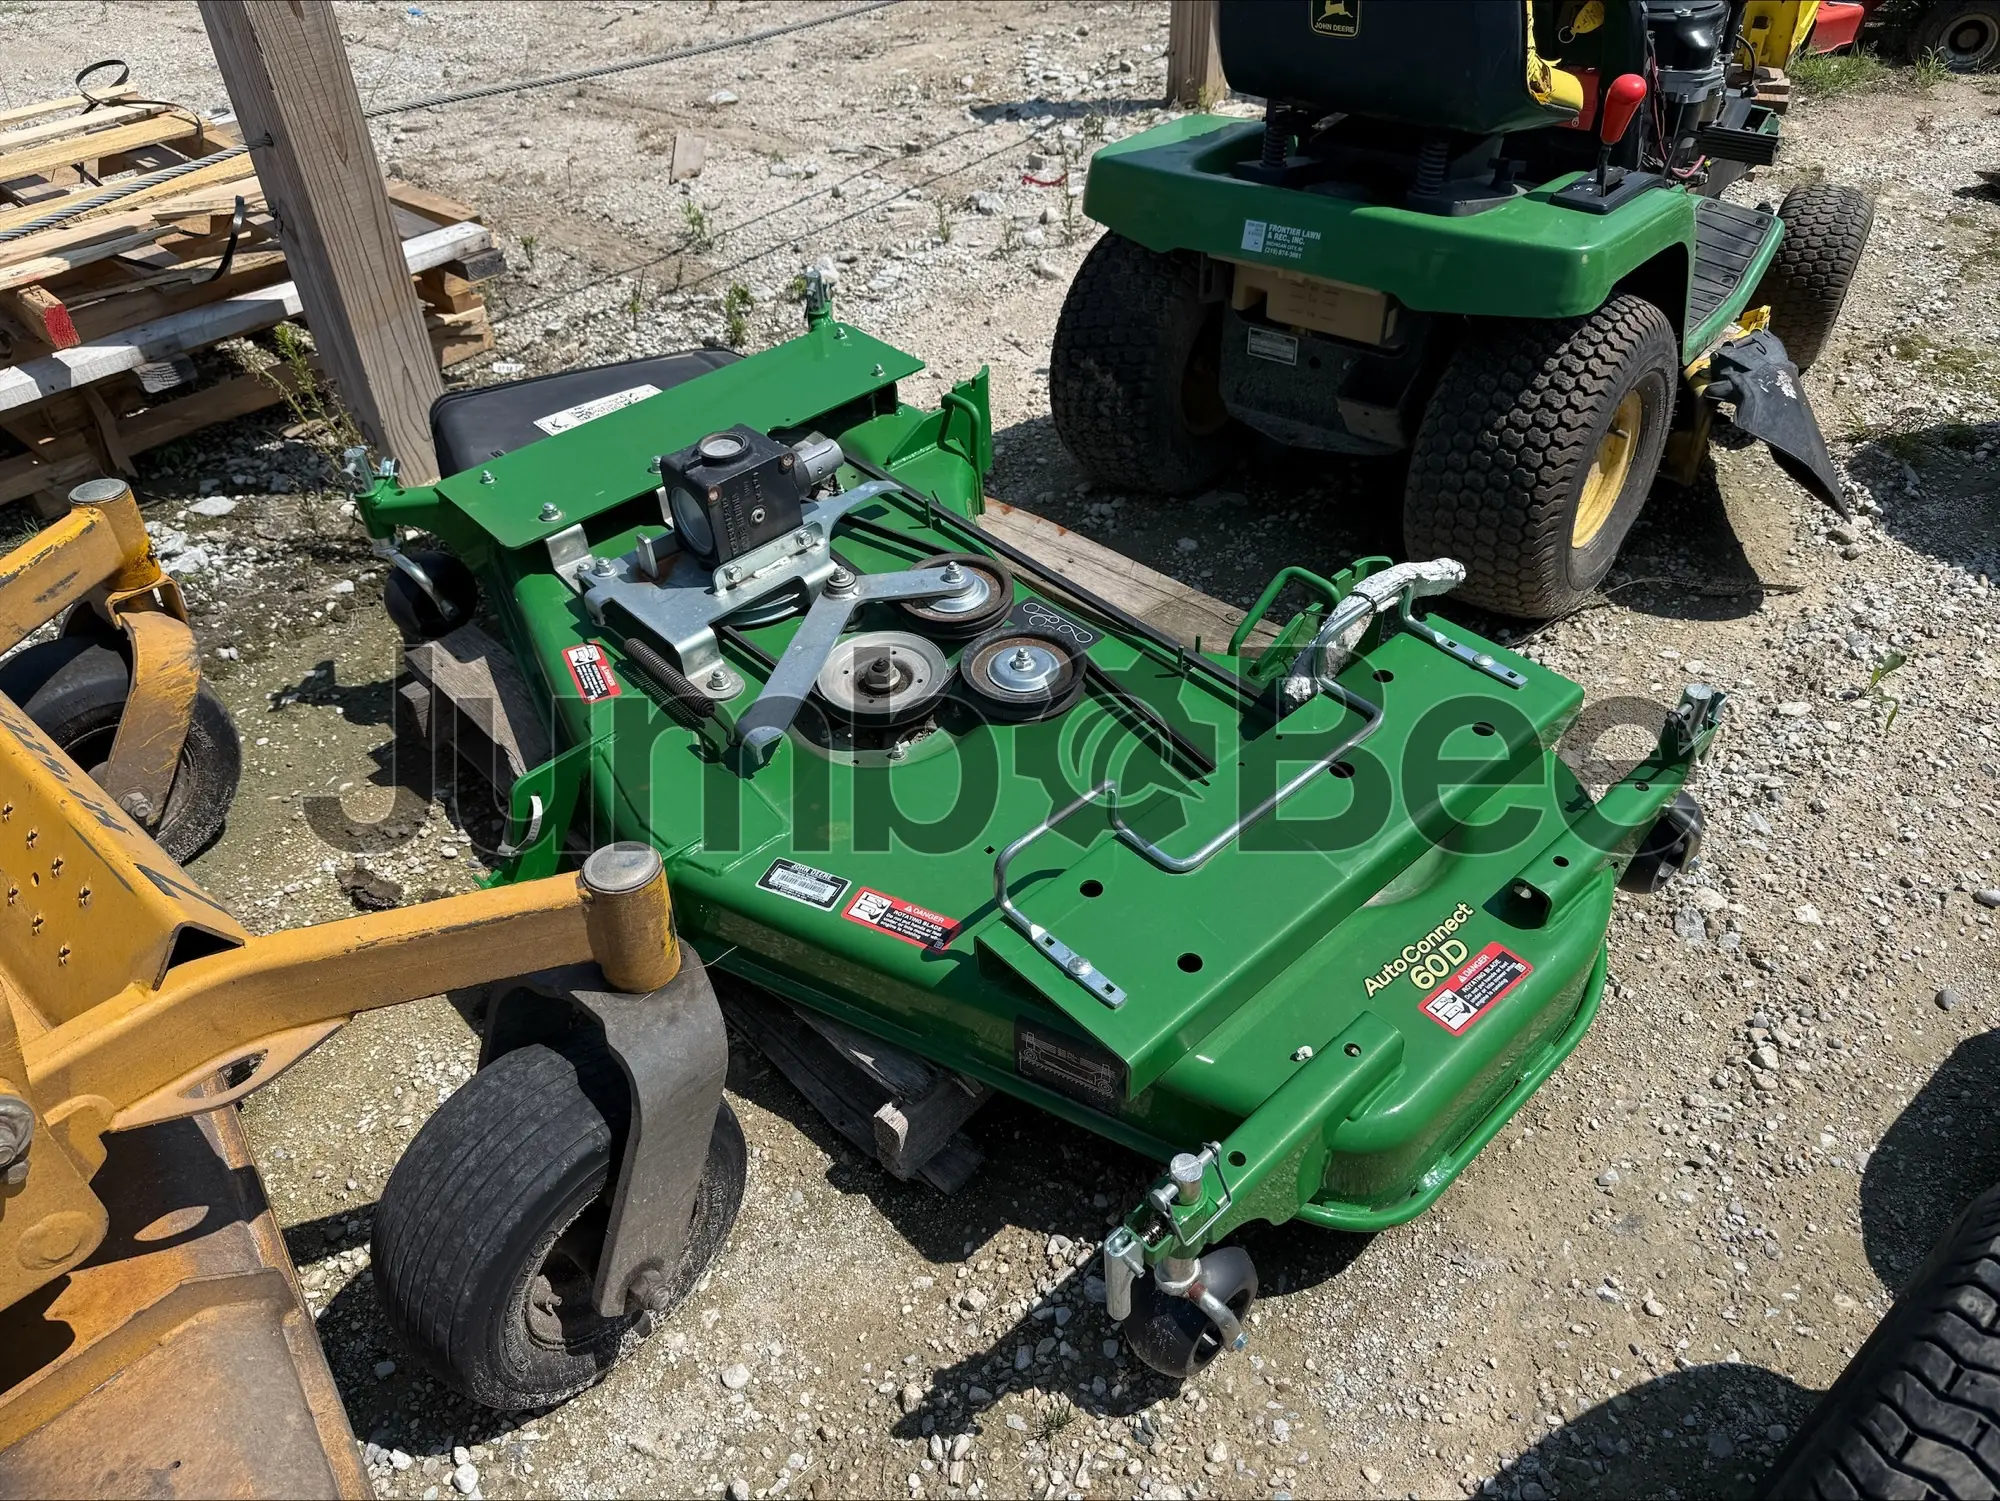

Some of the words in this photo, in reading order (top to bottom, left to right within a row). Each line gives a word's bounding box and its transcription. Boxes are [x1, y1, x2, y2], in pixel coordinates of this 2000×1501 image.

[1315, 22, 1332, 30] JOHN
[1333, 24, 1354, 33] DEERE
[1268, 223, 1301, 236] FRONTIER
[1301, 229, 1321, 240] LAWN
[791, 863, 809, 873] JOHN
[810, 869, 832, 880] DEERE
[892, 909, 922, 924] ROTATING
[922, 920, 942, 931] BLADE
[912, 907, 944, 923] DANGER
[1364, 902, 1474, 998] AutoConnect
[1410, 939, 1468, 989] 60D
[1461, 970, 1487, 993] ROTATING
[1483, 957, 1501, 973] BLADE
[1462, 952, 1490, 978] DANGER
